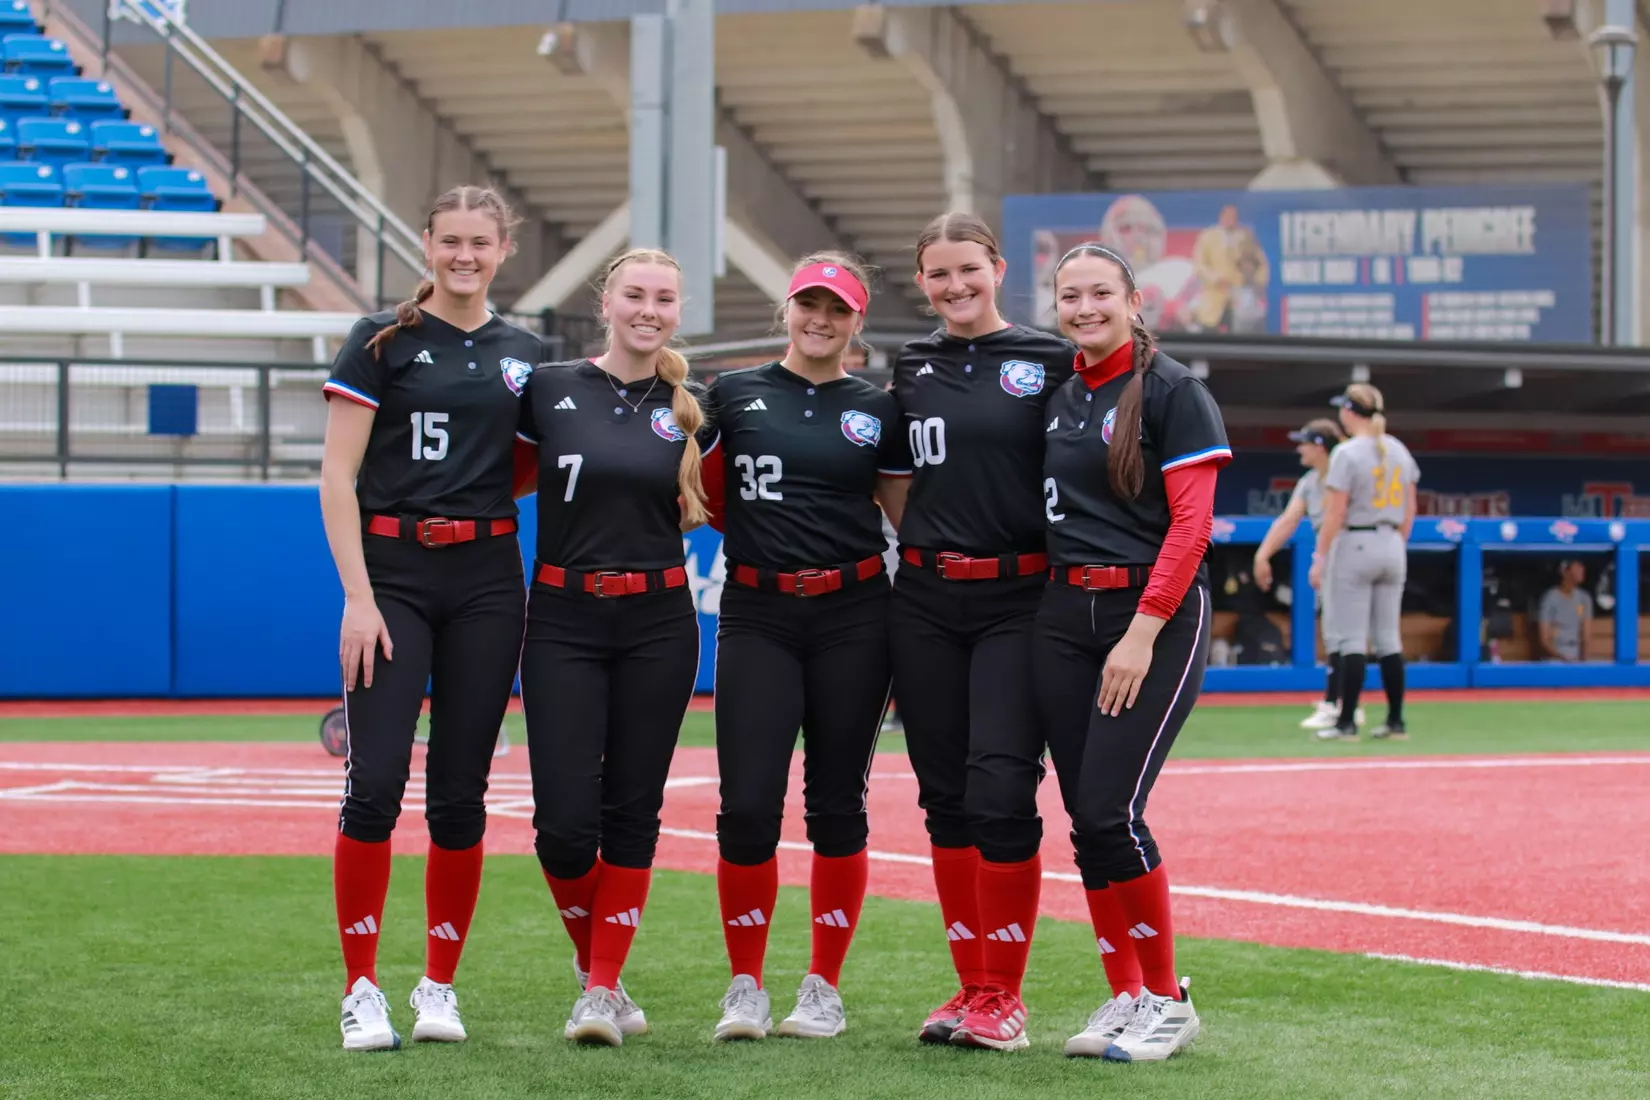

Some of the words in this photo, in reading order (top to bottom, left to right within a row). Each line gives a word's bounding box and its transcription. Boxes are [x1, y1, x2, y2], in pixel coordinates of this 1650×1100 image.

[410, 411, 449, 461] 15
[908, 416, 947, 468] 00
[557, 453, 584, 502] 7
[733, 453, 783, 501] 32
